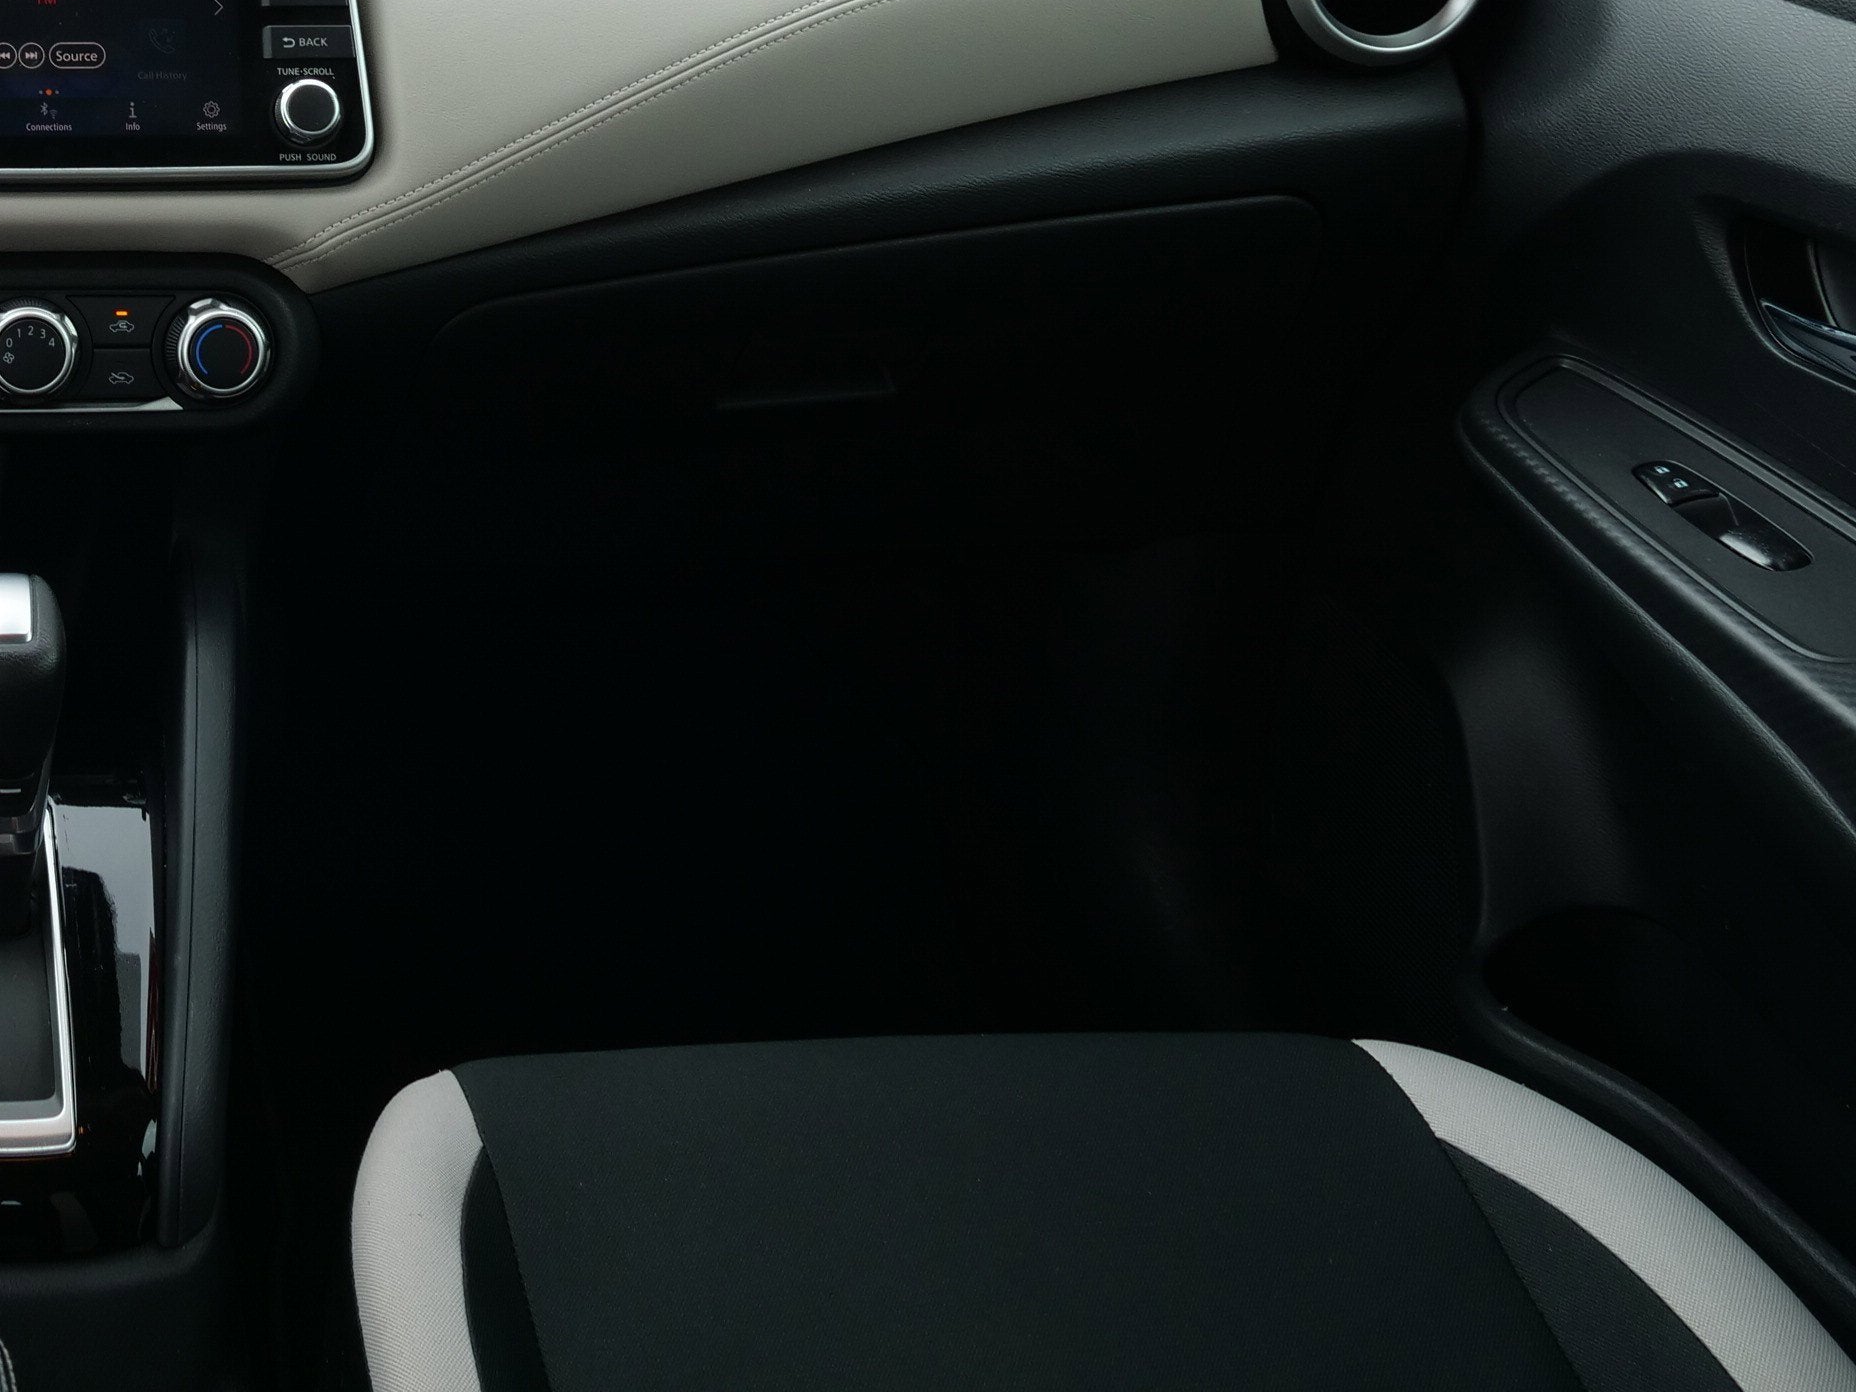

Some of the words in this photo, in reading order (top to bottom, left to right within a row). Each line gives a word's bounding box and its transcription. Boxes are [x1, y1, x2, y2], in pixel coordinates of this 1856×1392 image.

[298, 37, 329, 47] BACK
[55, 49, 99, 64] Source
[137, 71, 154, 80] Call
[156, 71, 187, 81] History
[25, 121, 73, 133] Connections
[125, 122, 141, 132] Info
[195, 121, 228, 135] Settings
[279, 153, 303, 162] PUSH
[306, 153, 338, 162] SOUND
[27, 325, 35, 337] 2
[39, 329, 47, 340] 3
[5, 337, 14, 349] 0
[48, 336, 56, 348] 4
